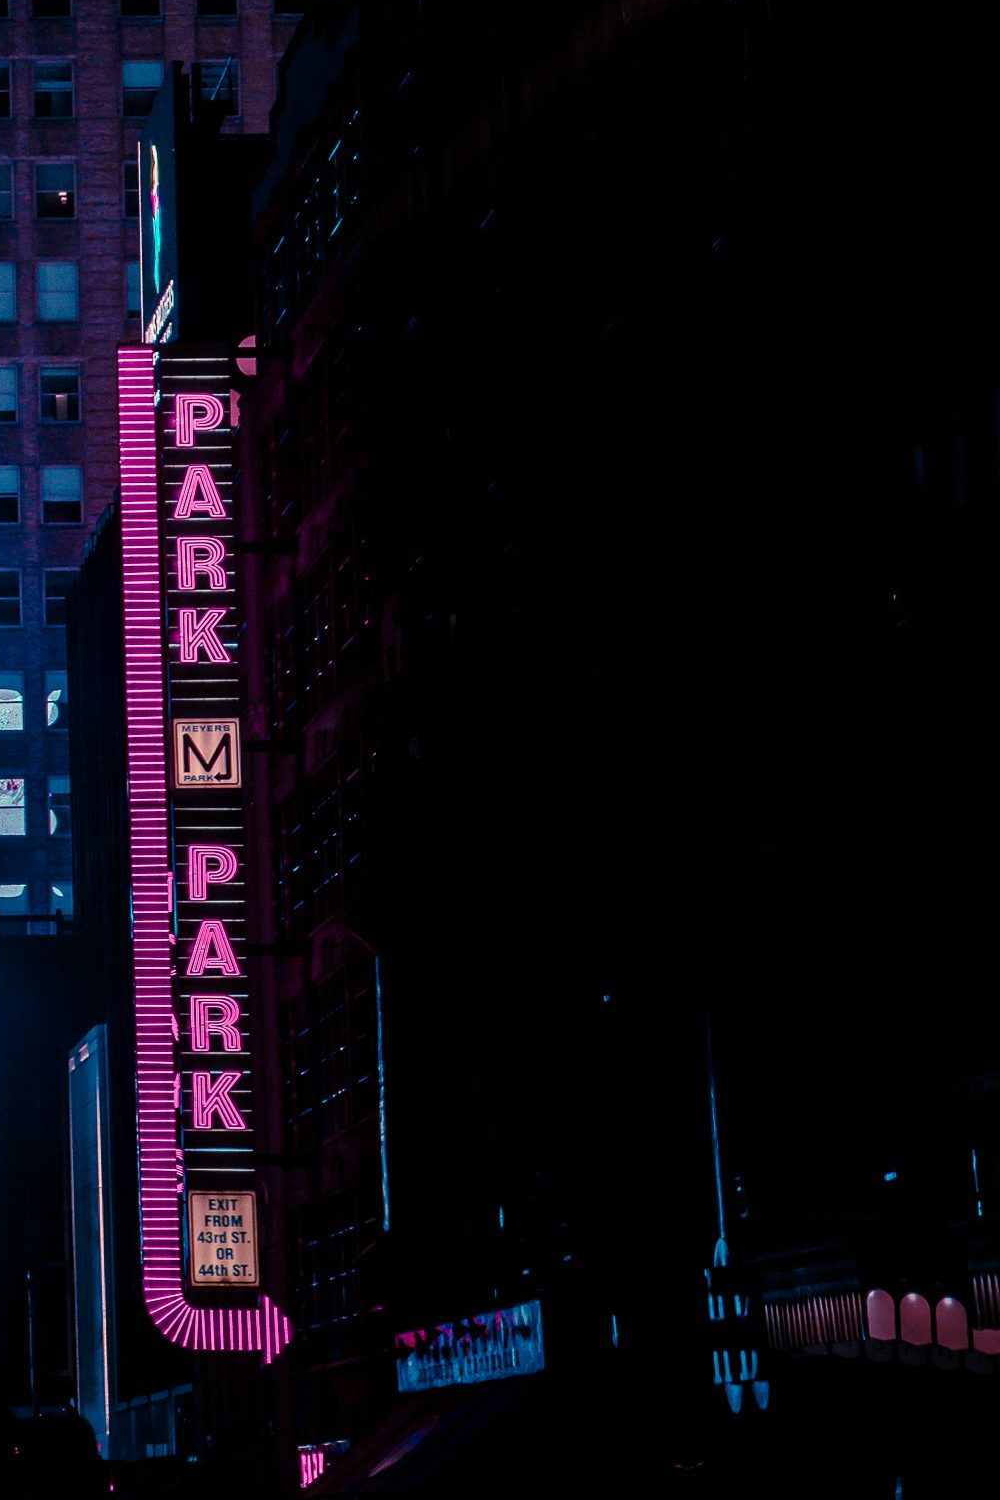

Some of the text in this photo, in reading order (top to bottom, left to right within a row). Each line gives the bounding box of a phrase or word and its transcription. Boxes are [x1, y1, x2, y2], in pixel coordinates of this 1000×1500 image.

[173, 393, 231, 663] PARK
[182, 724, 231, 732] MEYERS
[186, 844, 246, 1129] PARK
[208, 1198, 238, 1211] EXIT
[204, 1215, 243, 1228] FROM
[197, 1231, 251, 1243] 43rd ST.
[216, 1247, 234, 1260] OR
[199, 1264, 252, 1276] 44th ST.
